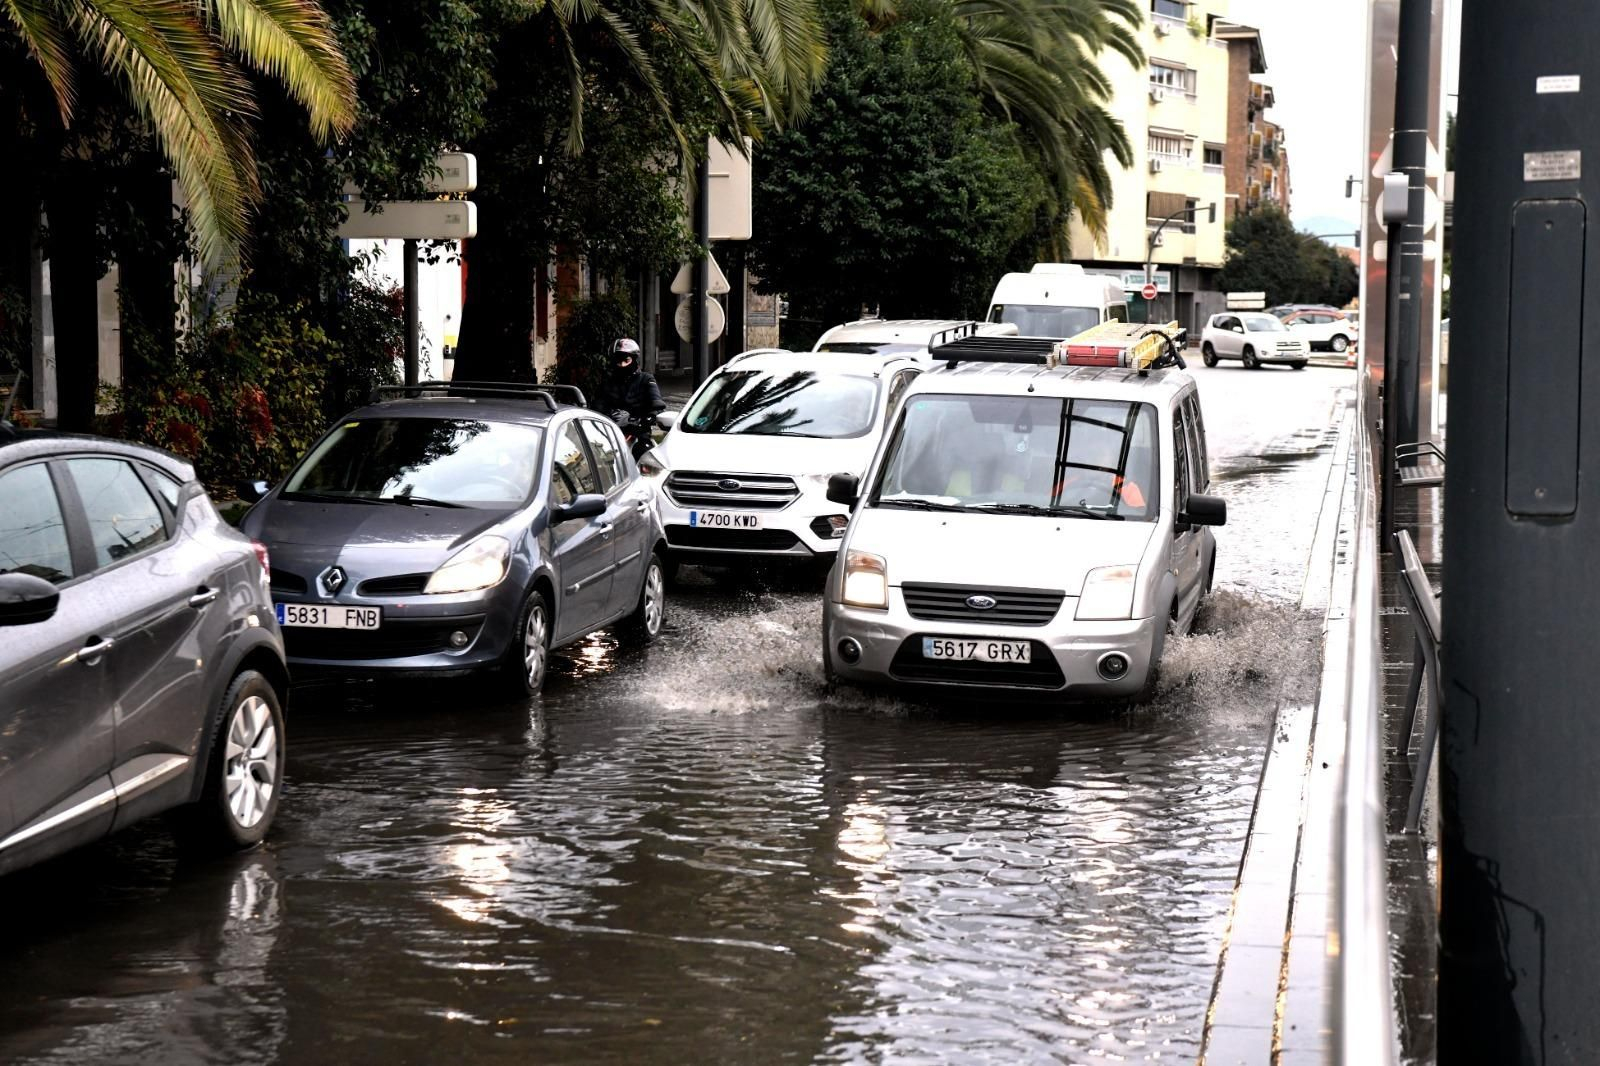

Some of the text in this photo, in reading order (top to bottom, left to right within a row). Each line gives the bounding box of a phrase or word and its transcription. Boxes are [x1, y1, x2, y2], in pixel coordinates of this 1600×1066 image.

[700, 513, 757, 527] 4700 KWD
[288, 606, 377, 627] 5831 FNB
[933, 640, 1025, 660] 5617 GRX
